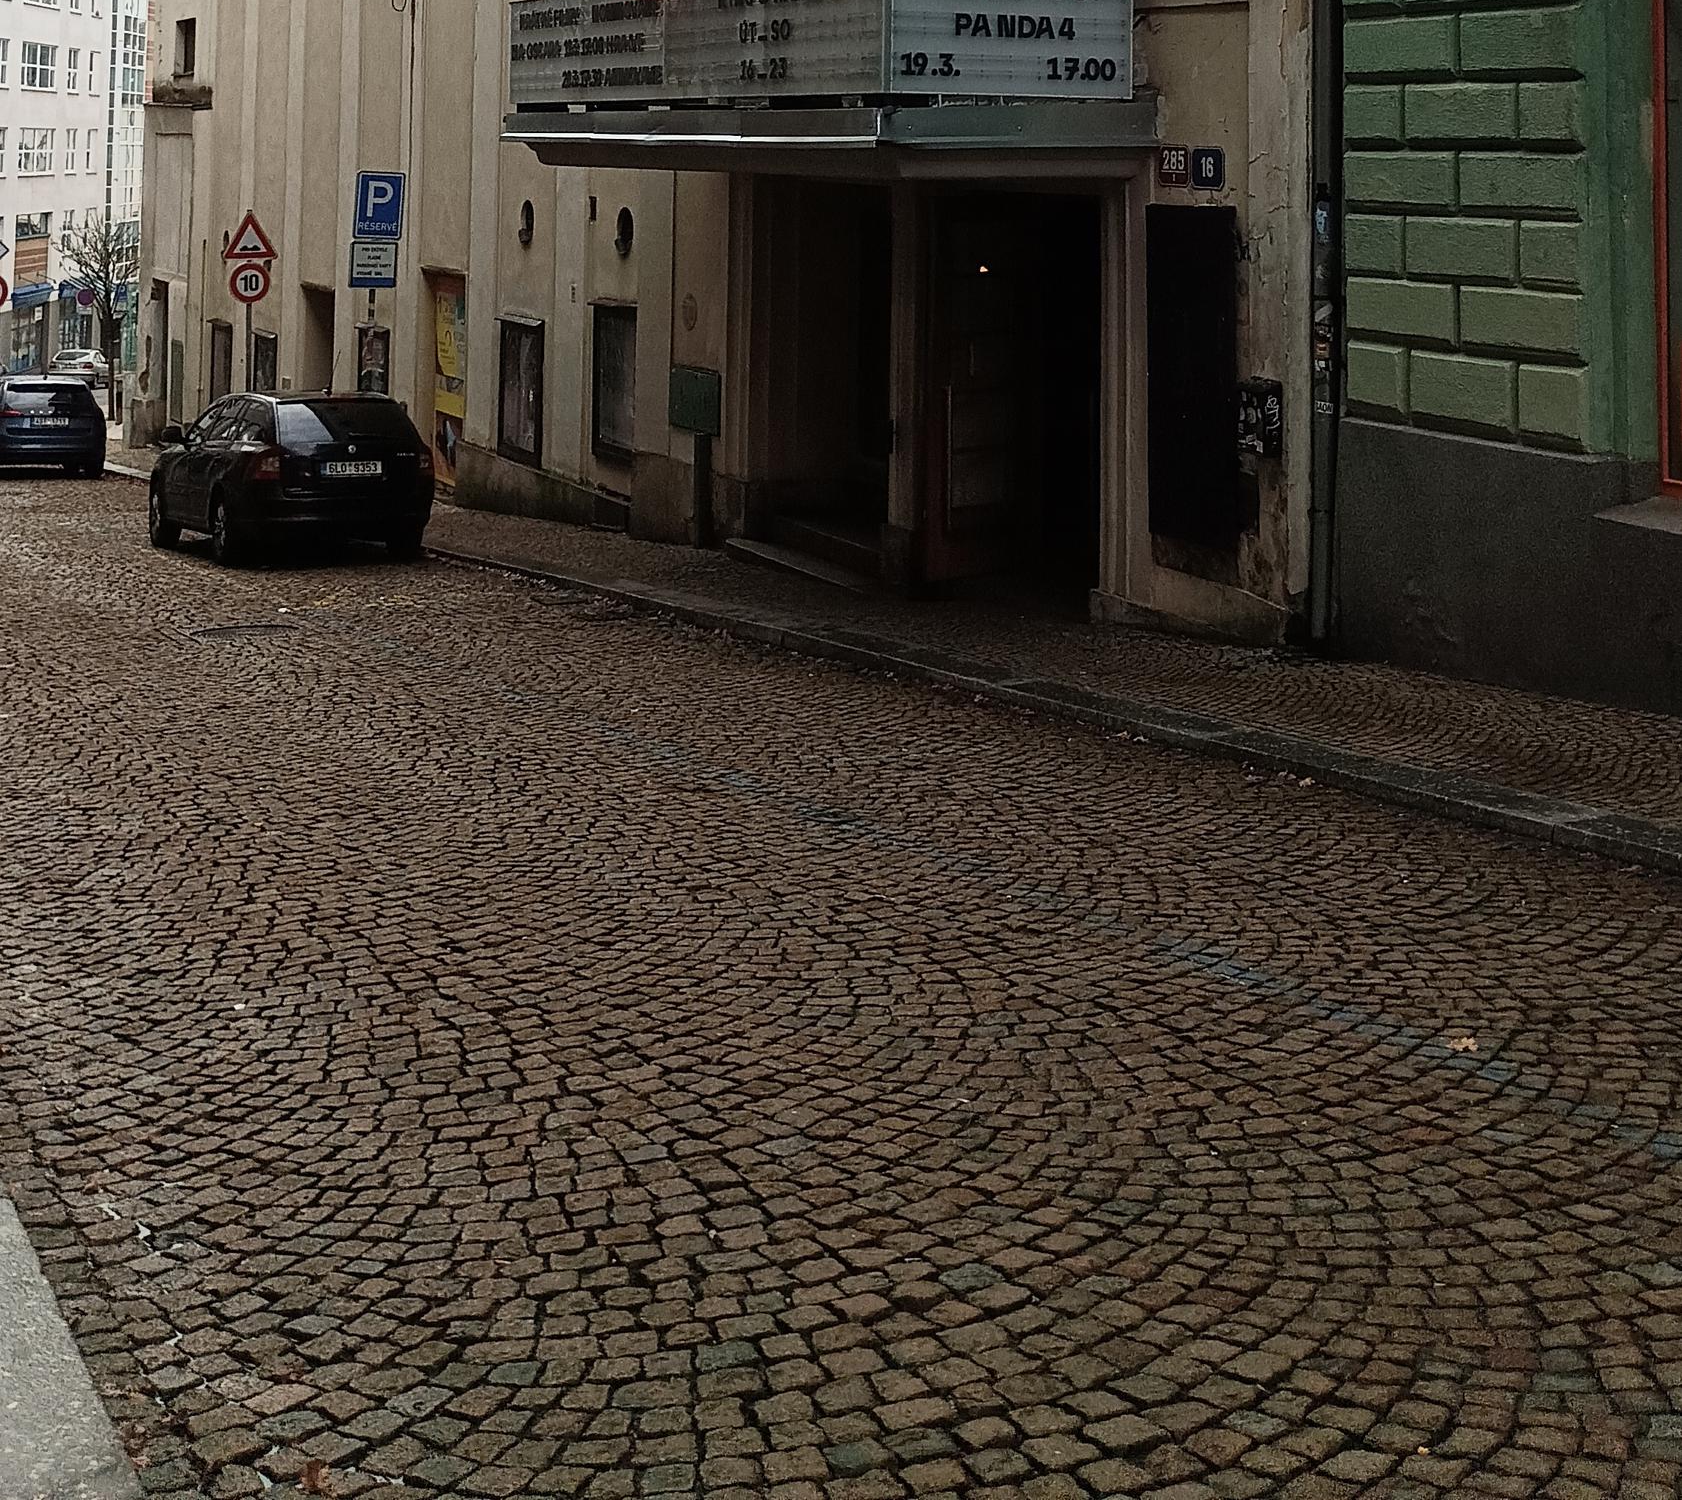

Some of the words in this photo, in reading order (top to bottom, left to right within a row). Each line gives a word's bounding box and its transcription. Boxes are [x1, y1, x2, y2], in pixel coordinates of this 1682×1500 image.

[900, 51, 961, 77] 19.3.
[1047, 56, 1117, 81] 17.00
[1162, 150, 1185, 170] 285
[1200, 156, 1214, 178] 16
[366, 180, 394, 218] P
[240, 274, 260, 292] 10
[353, 462, 378, 473] 9353
